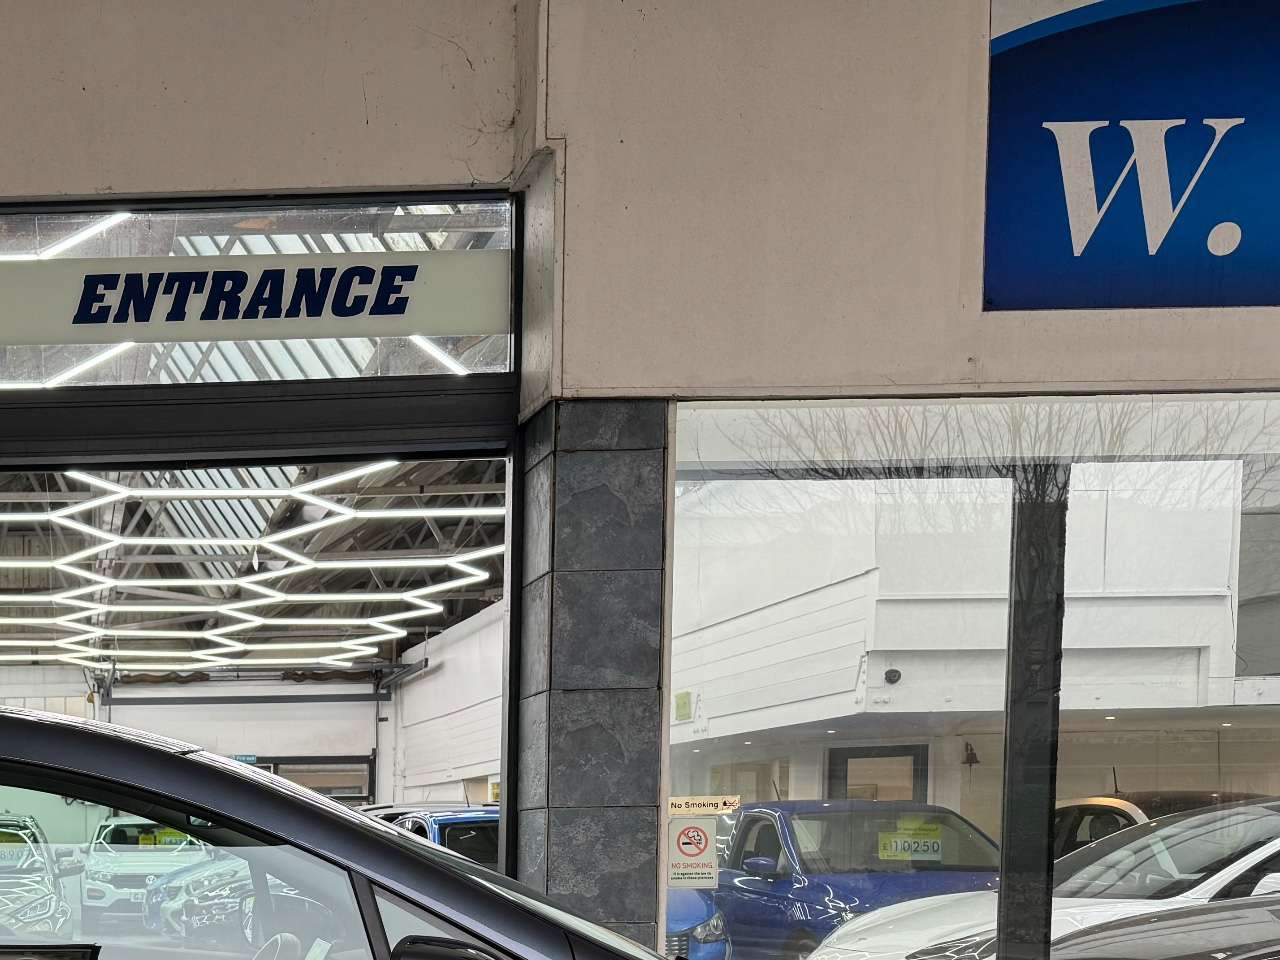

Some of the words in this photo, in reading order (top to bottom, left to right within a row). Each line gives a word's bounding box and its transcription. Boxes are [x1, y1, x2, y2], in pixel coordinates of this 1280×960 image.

[1042, 117, 1246, 256] W.
[72, 265, 419, 325] ENTRANCE
[685, 801, 719, 809] Smoking
